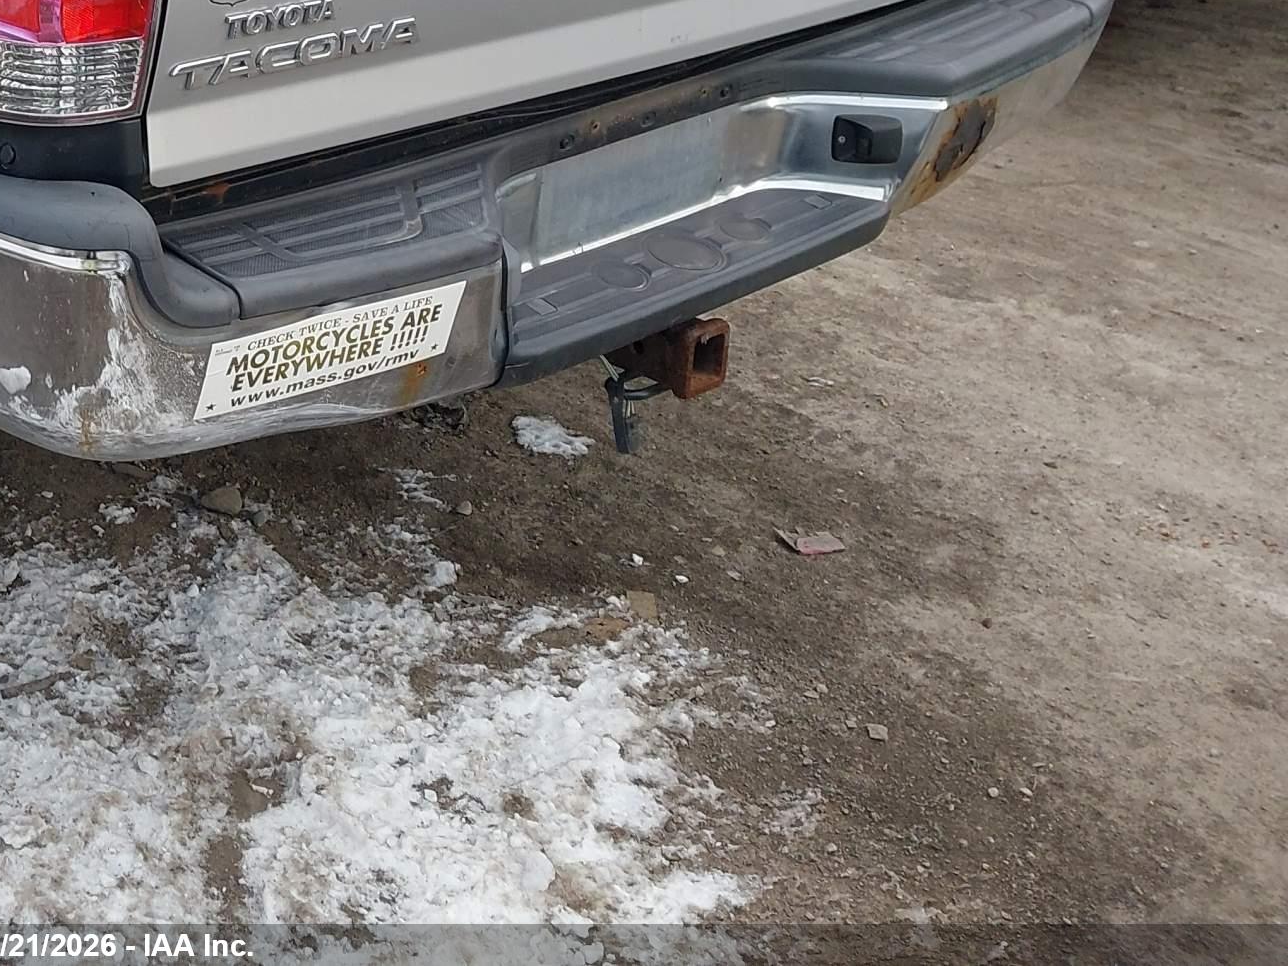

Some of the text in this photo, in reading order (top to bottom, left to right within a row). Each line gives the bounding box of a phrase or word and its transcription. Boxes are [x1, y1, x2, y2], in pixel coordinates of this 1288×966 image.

[169, 17, 417, 90] TACOMA
[225, 303, 443, 376] MOTORCYCLES ARE
[247, 331, 297, 351] CHECK
[298, 317, 342, 336] TWICE
[352, 308, 388, 324] SAVE
[390, 304, 401, 314] A
[403, 295, 434, 312] LIFE
[230, 348, 420, 408] www.mass.gov/rmv
[231, 337, 385, 392] EVERYWHERE
